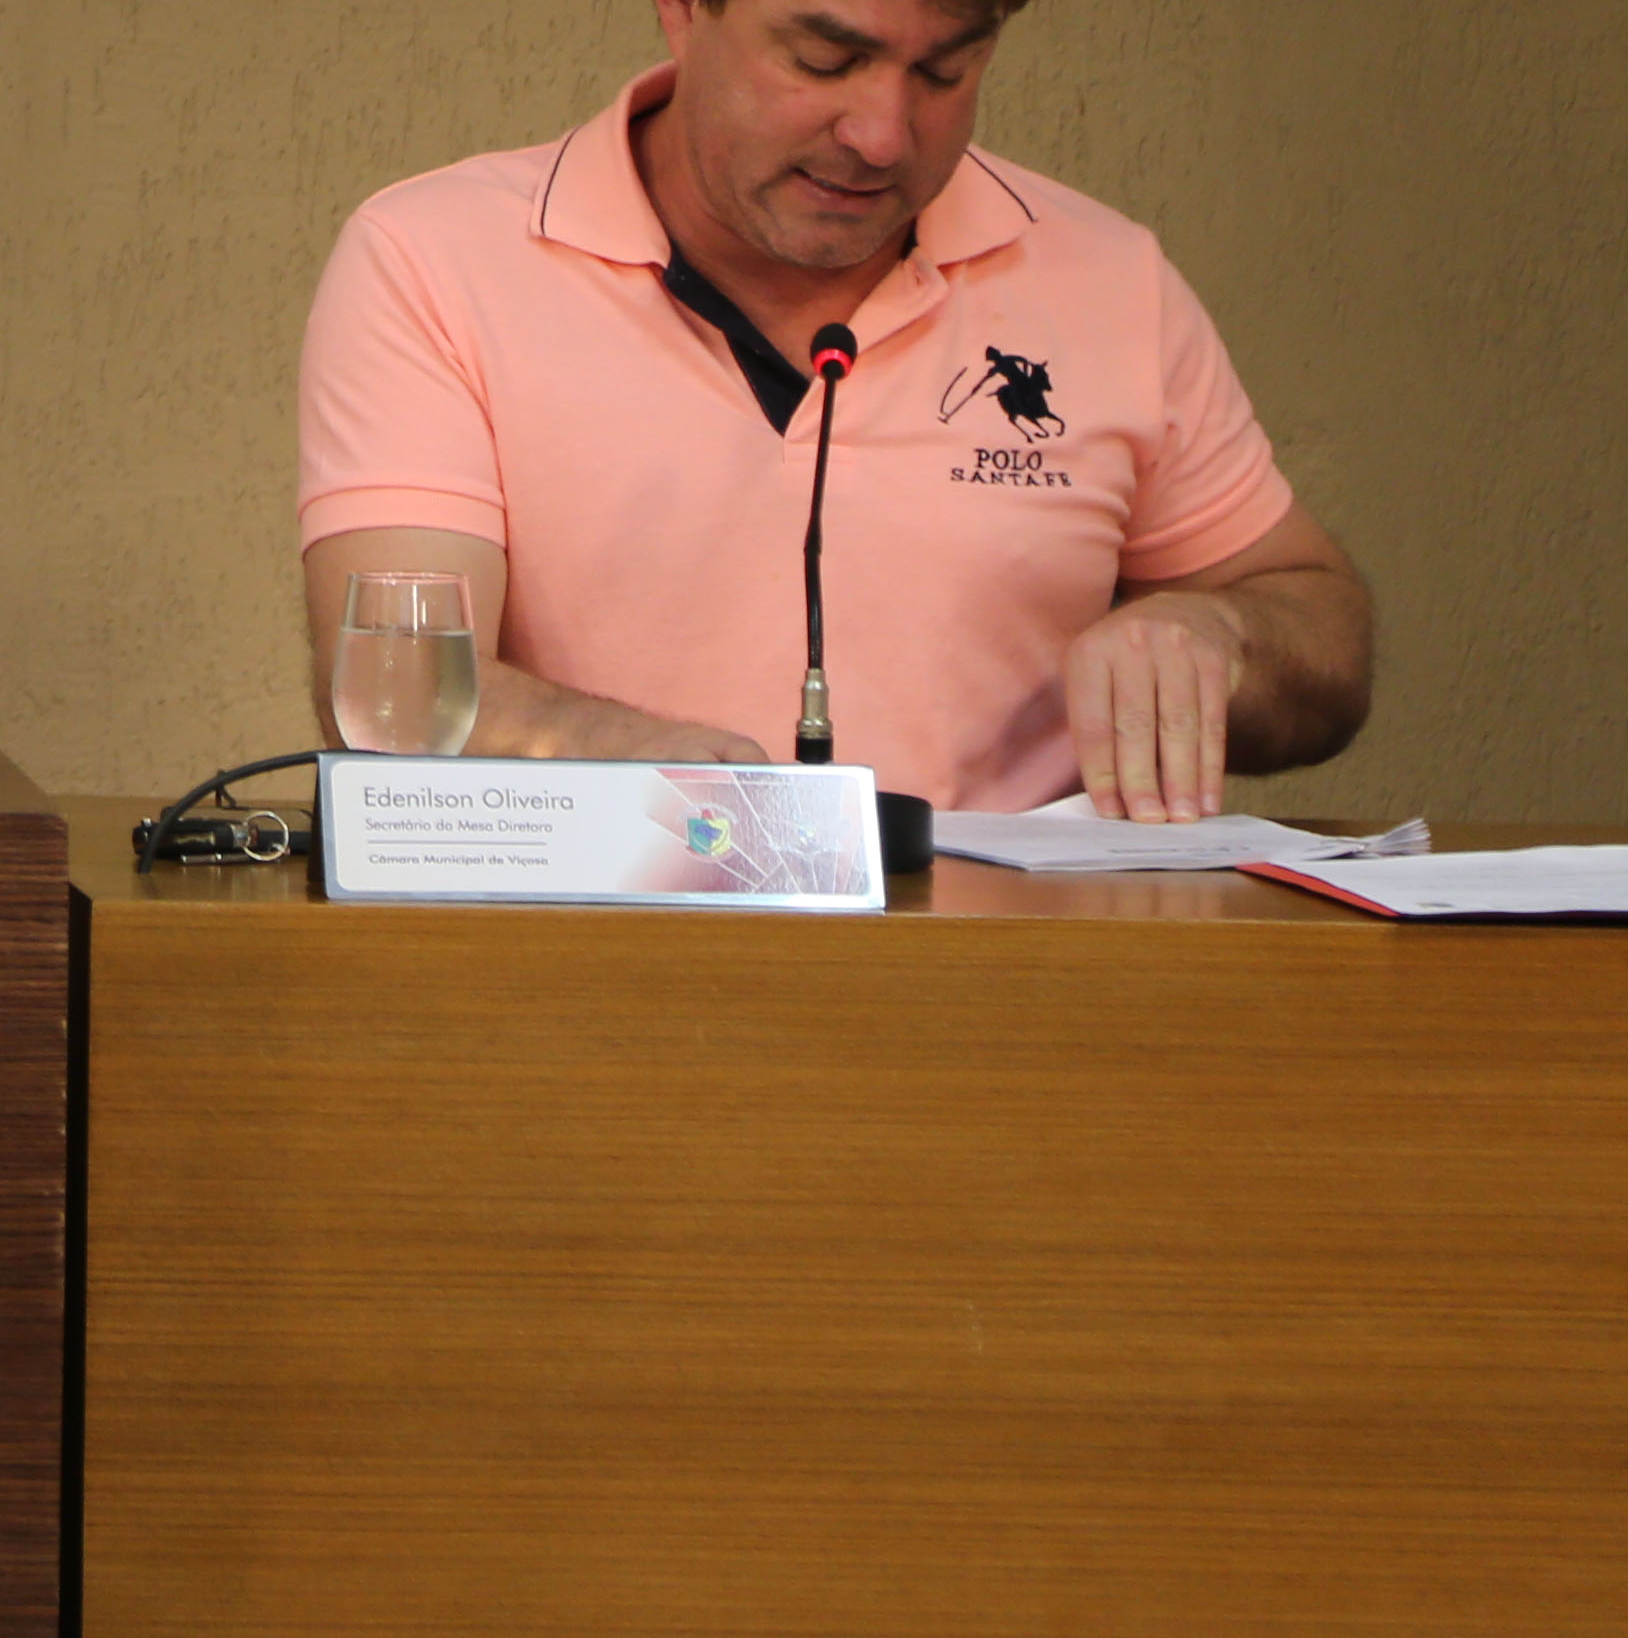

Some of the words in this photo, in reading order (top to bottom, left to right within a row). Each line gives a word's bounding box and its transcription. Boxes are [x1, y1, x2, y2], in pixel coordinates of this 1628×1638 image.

[974, 449, 1042, 471] POLO
[364, 786, 474, 809] Edenilson
[483, 788, 574, 810] Oliveira
[365, 818, 431, 832] Secretário
[436, 819, 453, 832] da
[458, 820, 494, 832] Mesa
[498, 820, 553, 833] Diretora
[424, 855, 485, 867] Municipal
[489, 855, 504, 866] de
